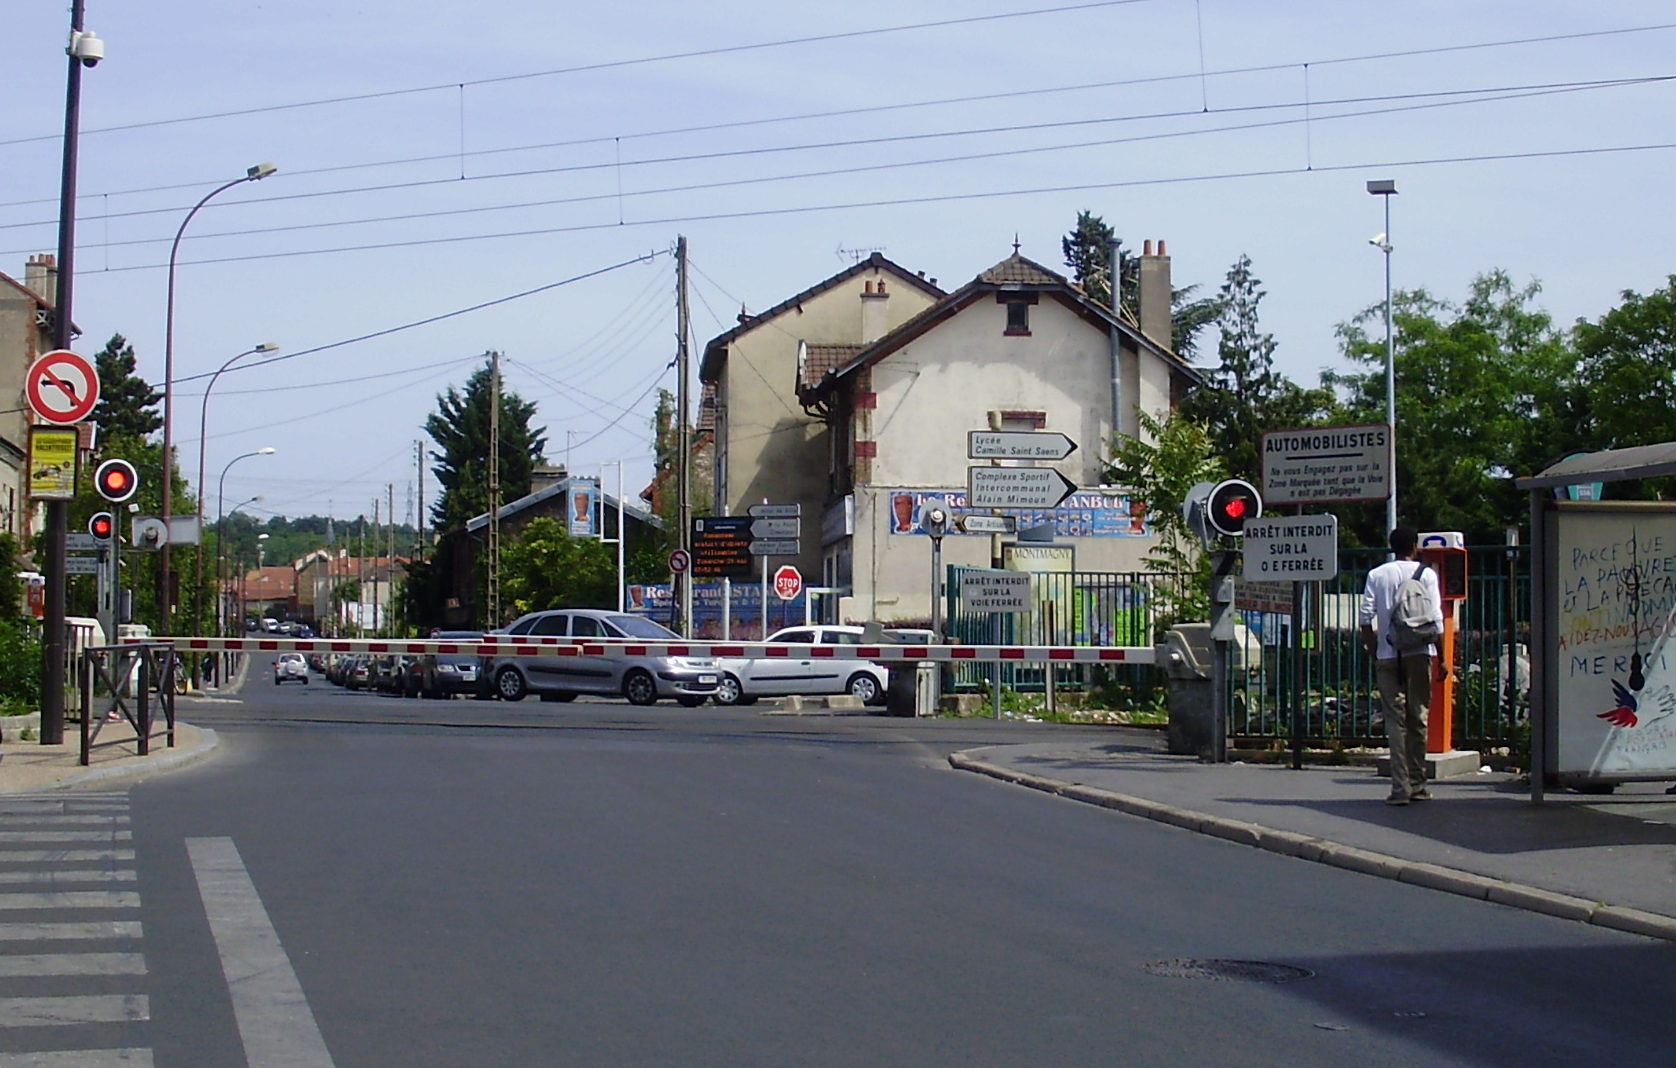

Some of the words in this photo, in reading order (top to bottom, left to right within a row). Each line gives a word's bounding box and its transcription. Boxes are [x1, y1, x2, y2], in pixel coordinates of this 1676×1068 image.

[975, 436, 1001, 445] Lycée
[1266, 432, 1385, 452] AUTOMOBILISTES
[975, 446, 1006, 455] Camille
[1010, 446, 1032, 455] Saint
[1035, 447, 1059, 456] Saens
[1271, 467, 1280, 476] Ne
[1284, 468, 1300, 476] vous
[1304, 465, 1336, 476] Engagez
[1339, 464, 1352, 473] pas
[1356, 463, 1368, 471] sur
[1372, 462, 1380, 470] la
[975, 472, 1017, 482] Complexe
[1020, 472, 1050, 482] Sportif
[1269, 479, 1286, 488] Zone
[1289, 477, 1320, 488] Marquée
[1323, 476, 1339, 485] tant
[1342, 477, 1355, 486] que
[1367, 474, 1383, 483] Voie
[975, 484, 1051, 493] Intercommunal
[1313, 488, 1326, 497] pas
[1329, 486, 1361, 497] Dégagée
[976, 495, 1002, 503] Alain
[1007, 495, 1046, 504] Mimoun
[1061, 495, 1123, 509] TANBUL
[1245, 525, 1280, 539] ARRÊT
[1283, 525, 1333, 538] INTERDIT
[1014, 548, 1070, 559] MONTMAGNY
[1270, 543, 1291, 555] SUR
[1294, 543, 1308, 554] LA
[1282, 558, 1324, 571] FERRÉE
[778, 577, 798, 588] STOP
[964, 577, 990, 585] ARRÊT
[992, 577, 1029, 585] INTERDIT
[982, 588, 998, 596] SUR
[1000, 588, 1011, 596] LA
[971, 599, 990, 607] VOIE
[991, 598, 1023, 607] FERRÉE
[1570, 653, 1666, 678] MERCI
